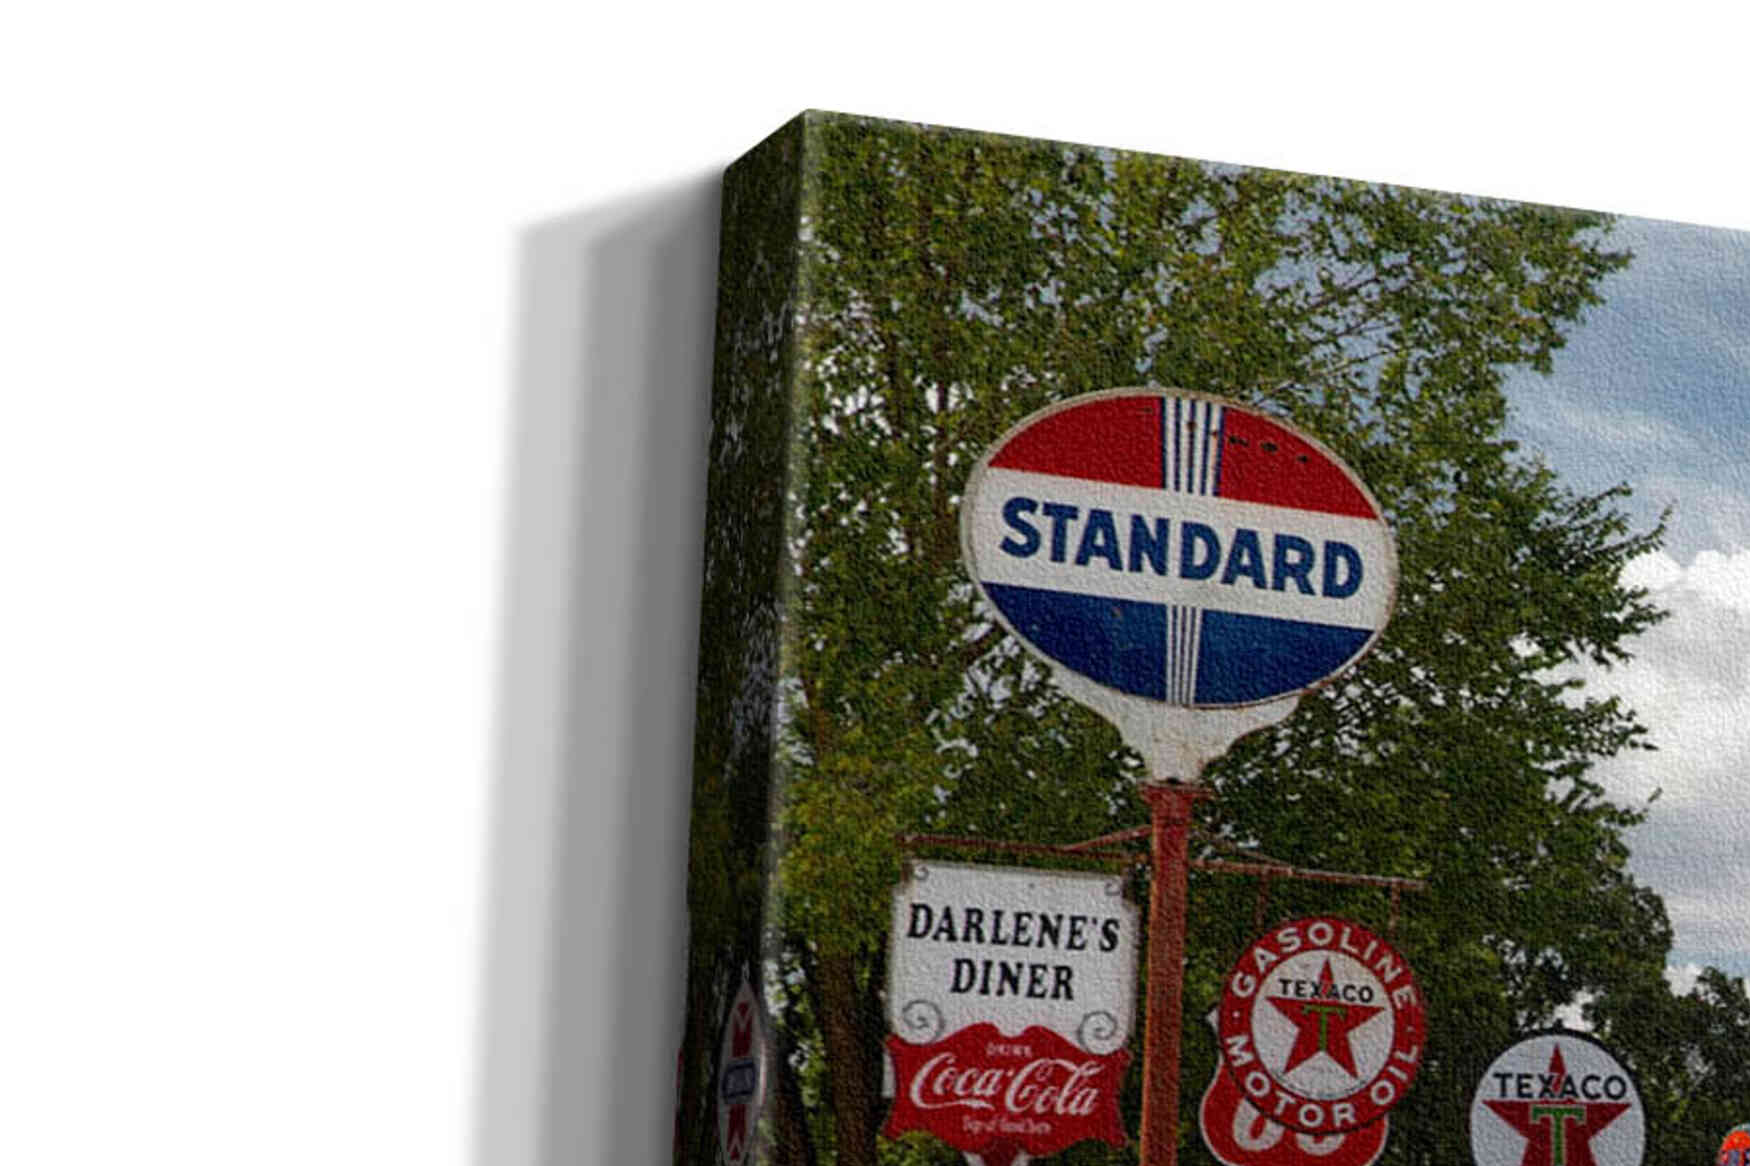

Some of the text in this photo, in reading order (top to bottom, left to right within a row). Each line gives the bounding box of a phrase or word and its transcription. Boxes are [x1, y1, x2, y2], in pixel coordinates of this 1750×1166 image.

[1000, 496, 1365, 600] STANDARD
[908, 903, 1121, 953] DARLENE'S
[950, 957, 1075, 1001] DINER
[1230, 922, 1419, 1010] GASOLINE
[1278, 977, 1375, 1005] TEXACO
[910, 1051, 1106, 1116] Coca-Cola
[1225, 1033, 1357, 1128] MOTOR
[1369, 1040, 1422, 1109] OIL
[1493, 1070, 1628, 1101] TEXACO
